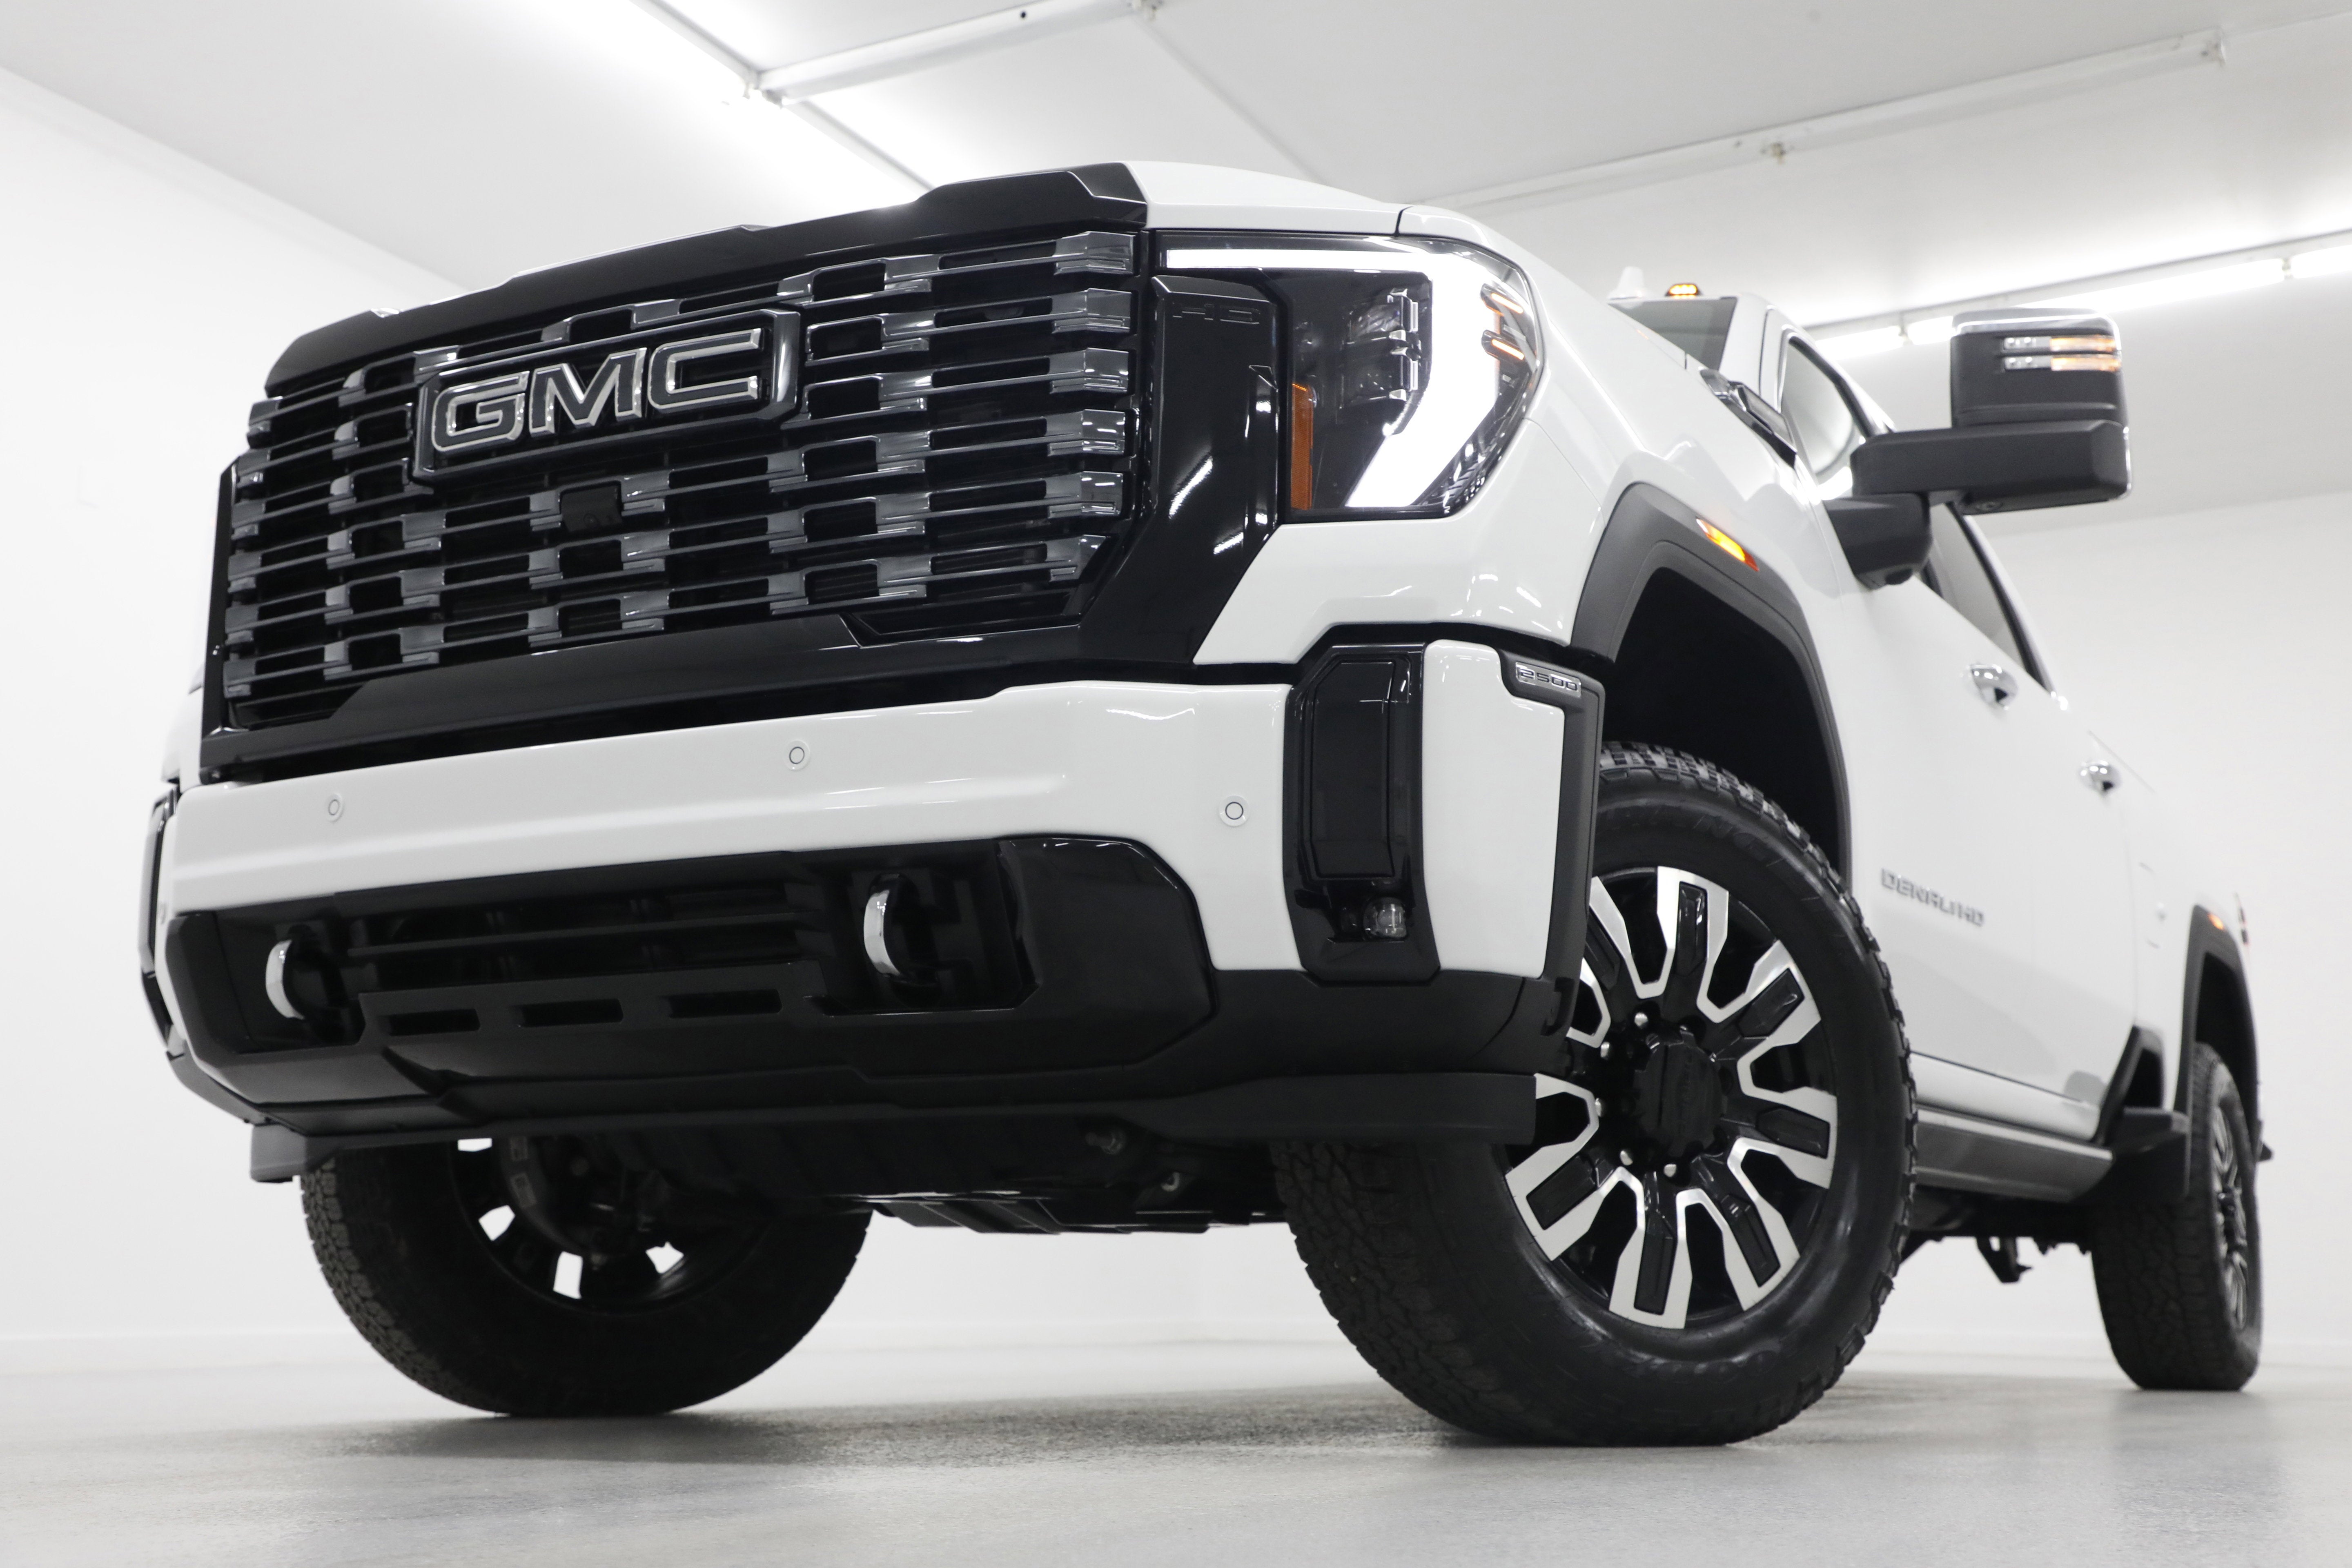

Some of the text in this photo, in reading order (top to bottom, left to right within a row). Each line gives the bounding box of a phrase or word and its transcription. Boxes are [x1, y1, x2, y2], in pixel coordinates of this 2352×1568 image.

[1171, 302, 1261, 325] HD
[431, 327, 762, 452] GMC
[1517, 664, 1578, 692] 2500
[1880, 867, 1955, 916] DENALI
